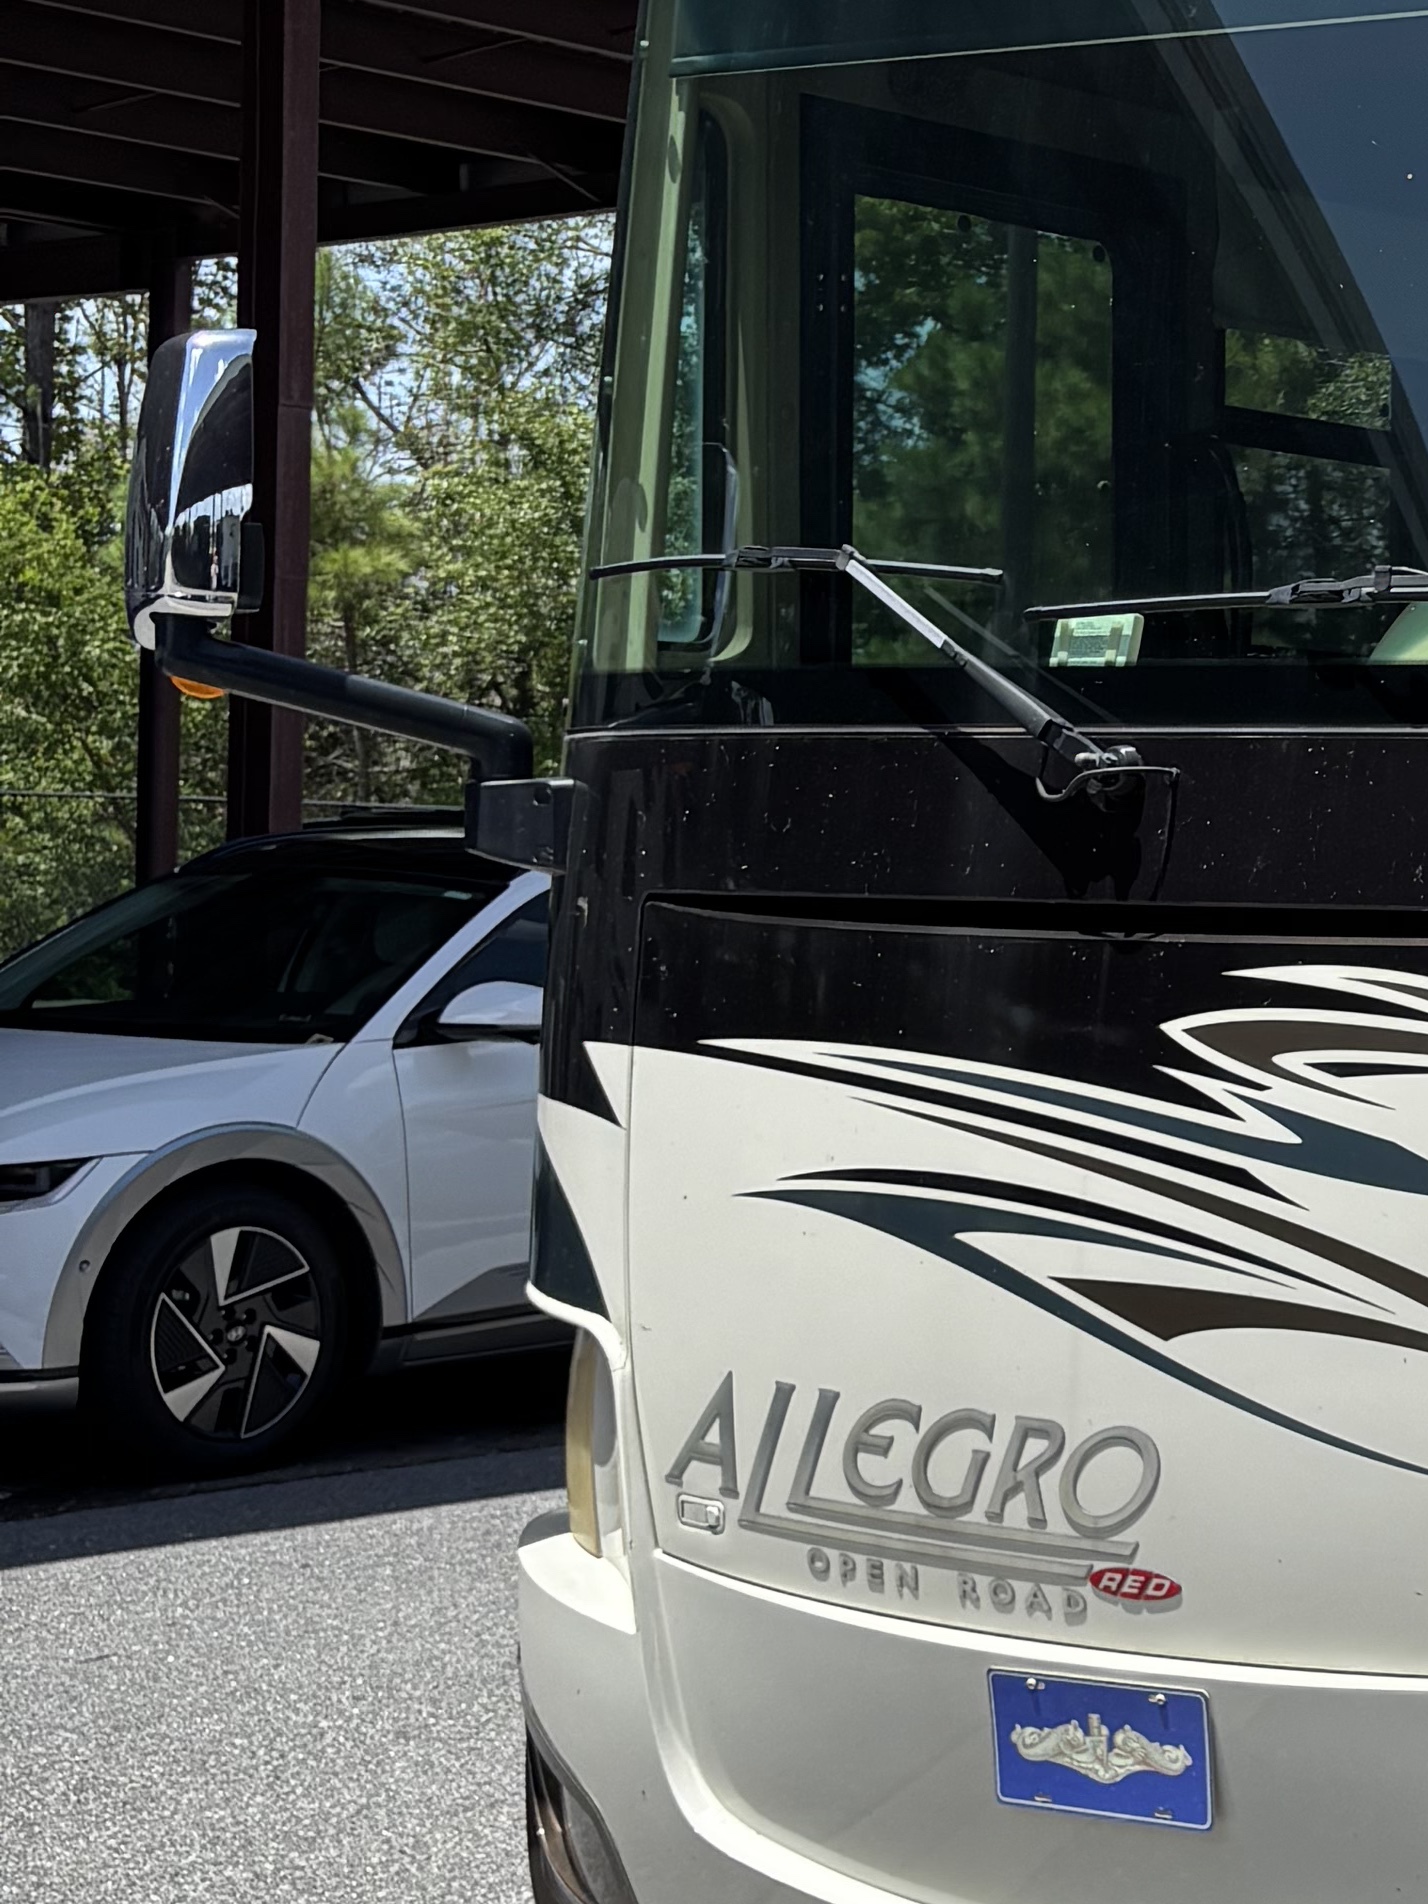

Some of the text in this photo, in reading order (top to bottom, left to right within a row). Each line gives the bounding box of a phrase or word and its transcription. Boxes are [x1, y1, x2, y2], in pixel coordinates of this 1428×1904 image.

[665, 1370, 1162, 1585] ALLEGRO
[807, 1547, 1088, 1626] OPEN ROAD
[1097, 1569, 1173, 1598] RED
